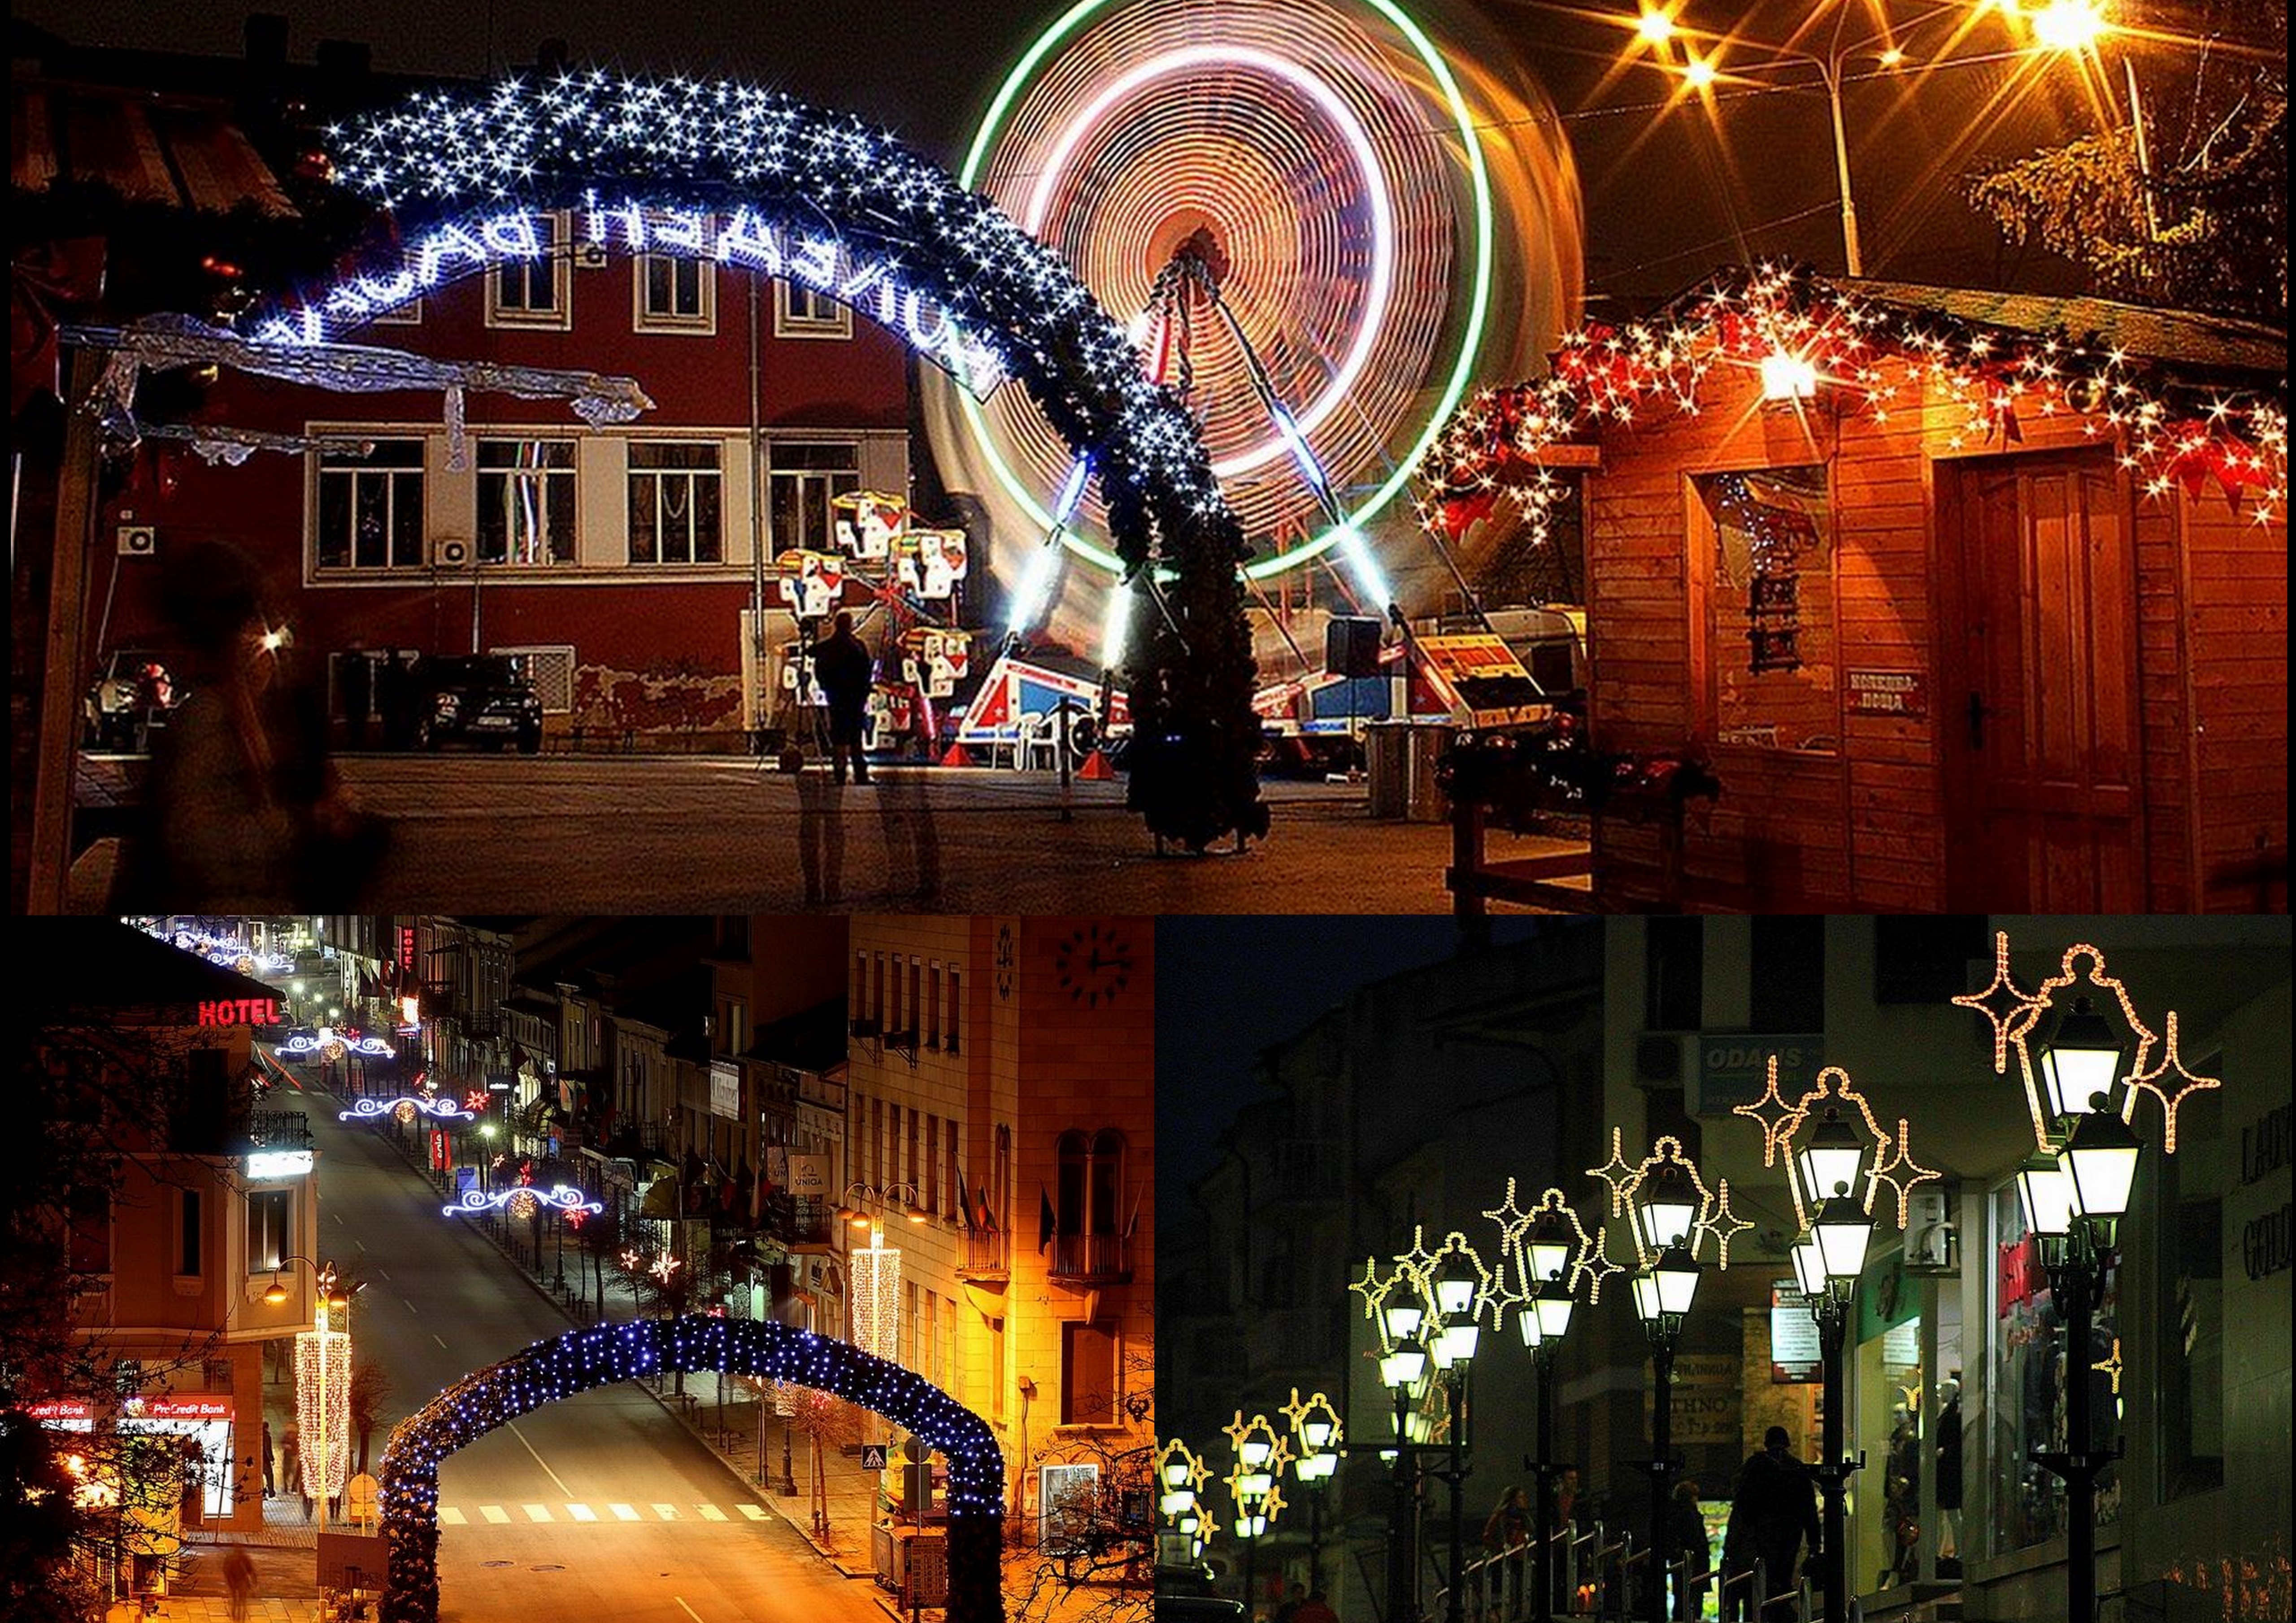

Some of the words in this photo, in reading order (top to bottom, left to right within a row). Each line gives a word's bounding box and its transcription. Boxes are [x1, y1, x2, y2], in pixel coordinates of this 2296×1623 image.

[198, 998, 281, 1027] HOTEL
[153, 1403, 199, 1415] ProCredit
[200, 1403, 226, 1415] Bank
